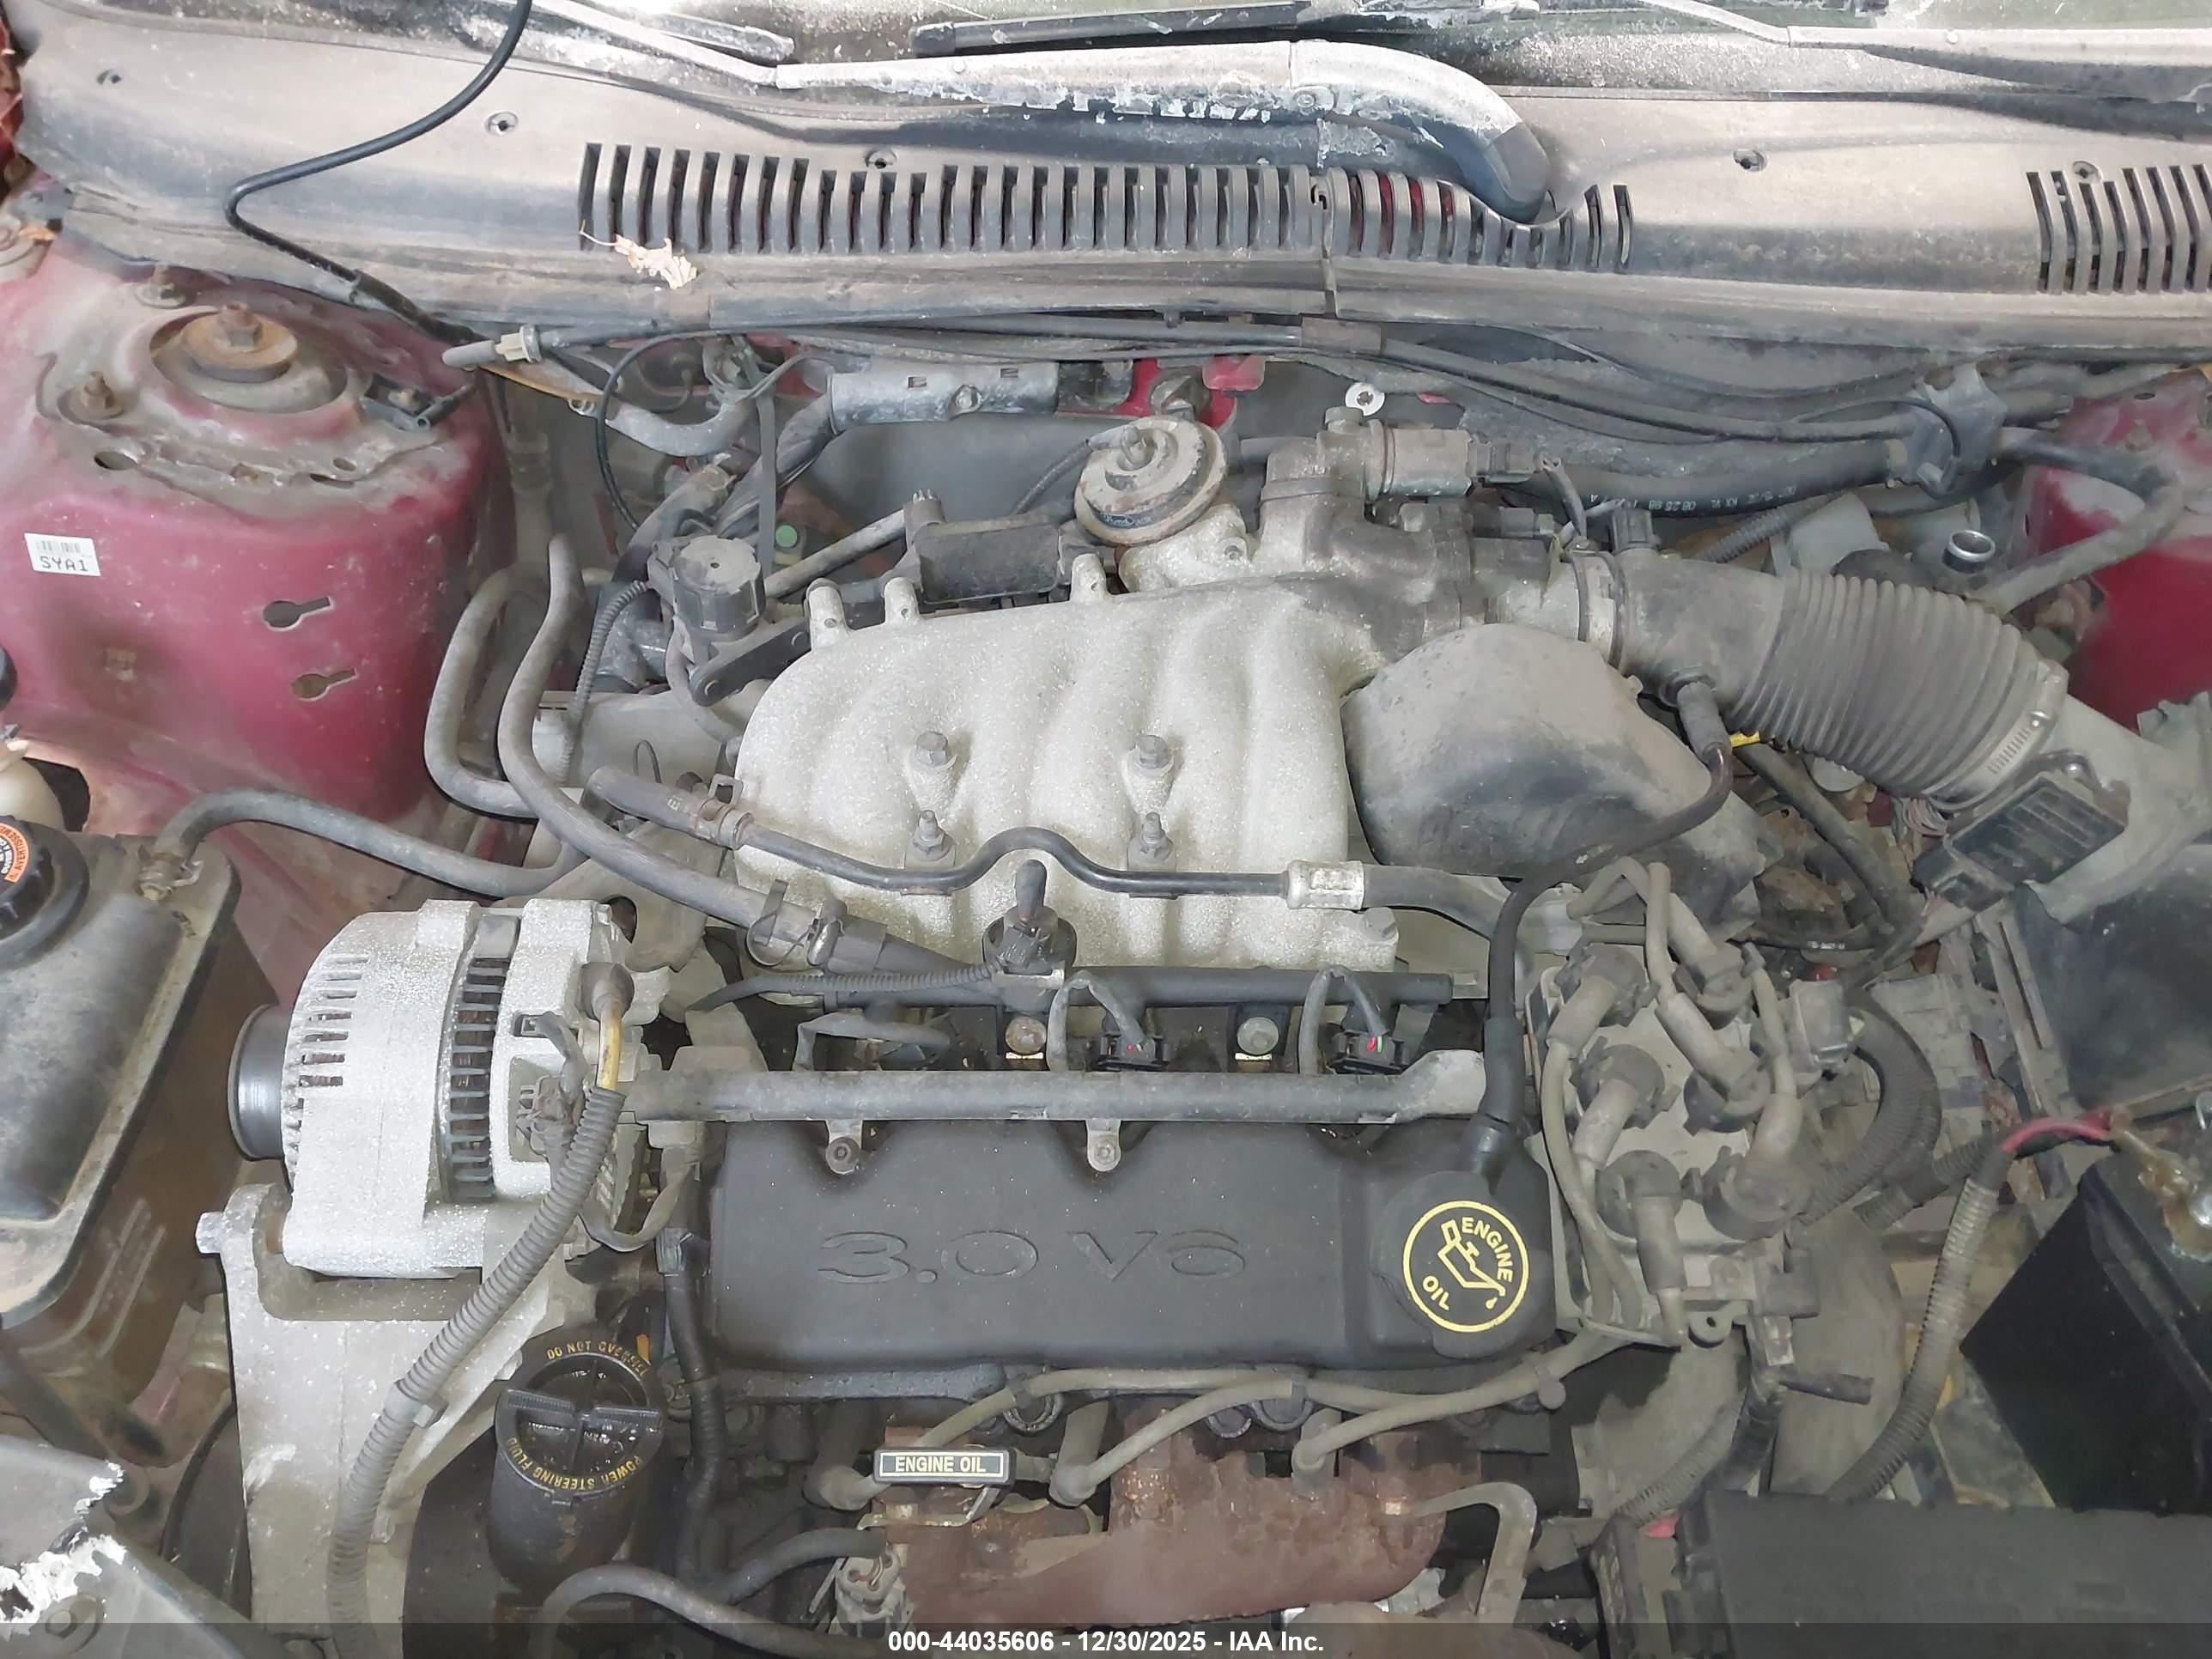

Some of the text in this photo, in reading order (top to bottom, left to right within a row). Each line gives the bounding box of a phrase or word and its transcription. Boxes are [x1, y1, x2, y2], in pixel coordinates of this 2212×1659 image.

[40, 556, 88, 572] SYA1
[817, 1230, 1245, 1284] 3.0 V6
[1462, 1217, 1514, 1283] ENGINE
[1422, 1276, 1449, 1310] OIL
[546, 1346, 563, 1360] DO
[567, 1340, 592, 1354] NOT
[507, 1437, 643, 1491] POWER STEERING FLUID
[895, 1455, 987, 1473] ENGINE OIL
